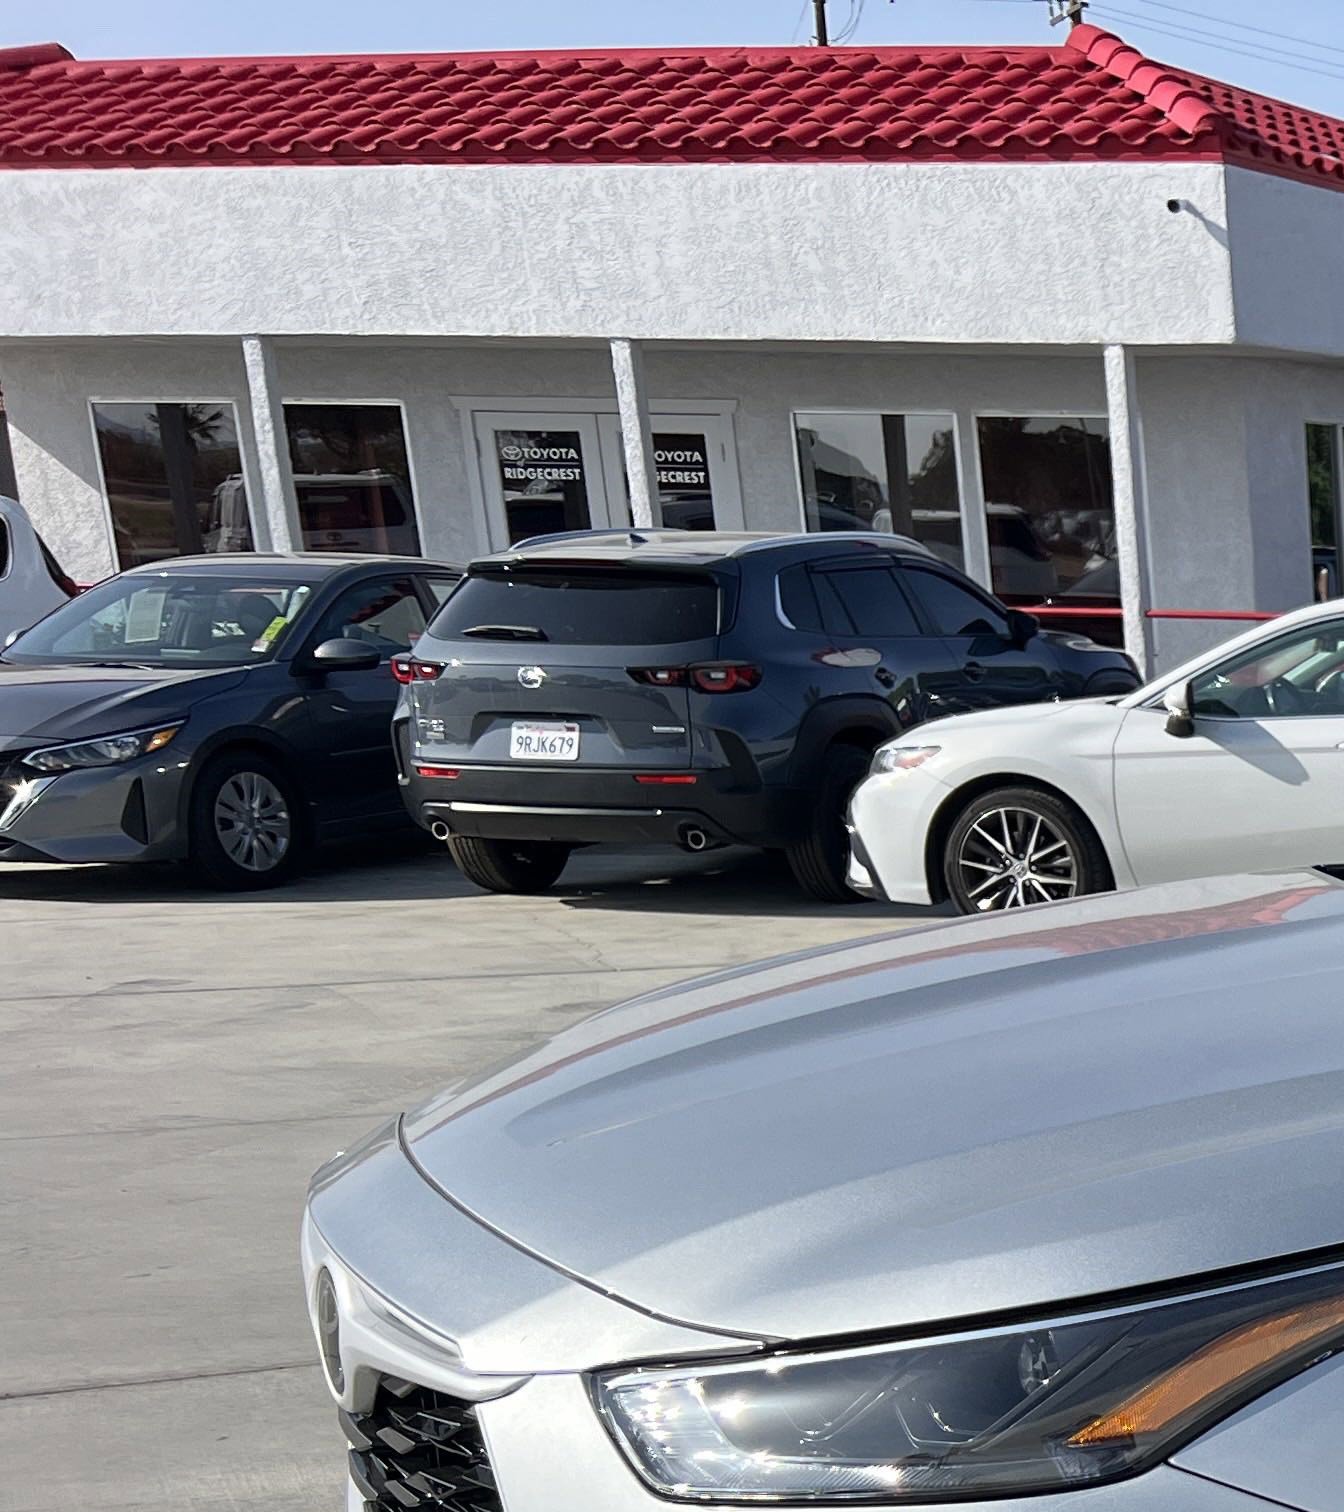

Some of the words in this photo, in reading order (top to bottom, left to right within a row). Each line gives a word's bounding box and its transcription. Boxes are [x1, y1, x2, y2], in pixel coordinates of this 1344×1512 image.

[522, 447, 579, 459] TOYOTA
[654, 450, 703, 463] OYOTA
[503, 467, 581, 480] RIDGECREST
[656, 471, 705, 484] ECREST
[515, 735, 574, 755] 9RJK679
